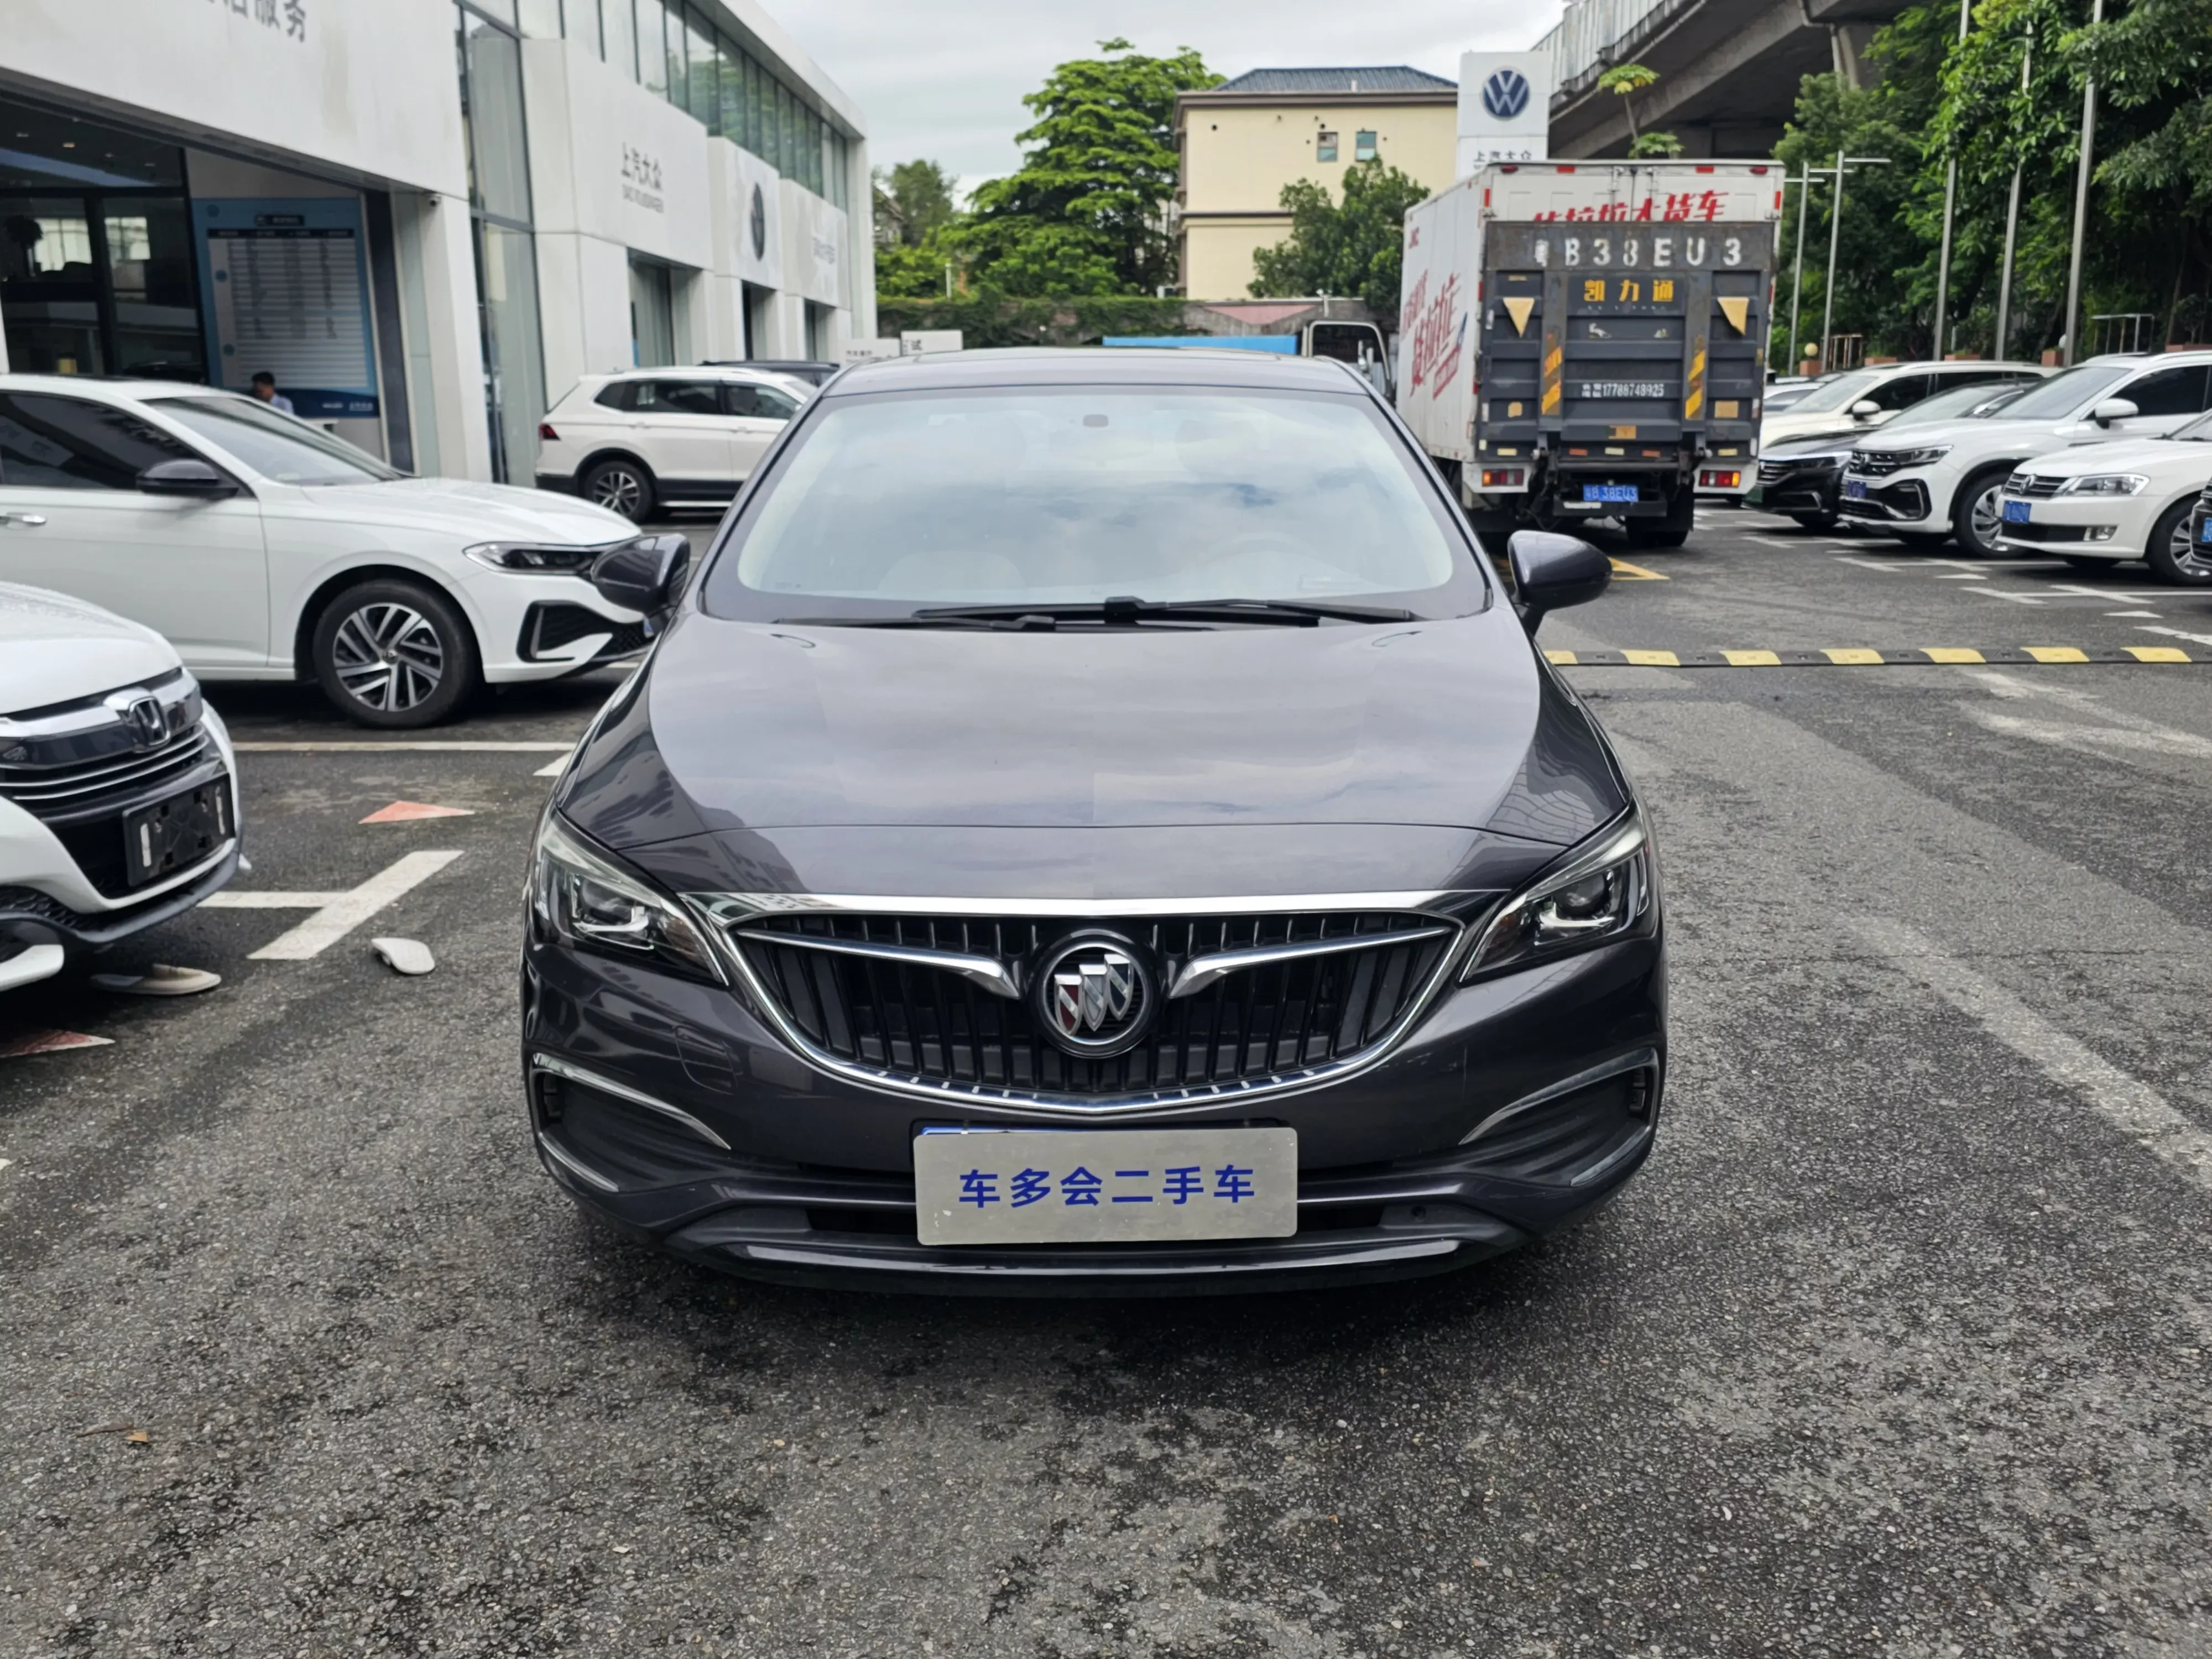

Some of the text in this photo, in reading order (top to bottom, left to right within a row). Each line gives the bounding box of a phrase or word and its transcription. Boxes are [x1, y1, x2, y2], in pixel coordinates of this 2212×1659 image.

[958, 1164, 1255, 1208] 车多会二手车
